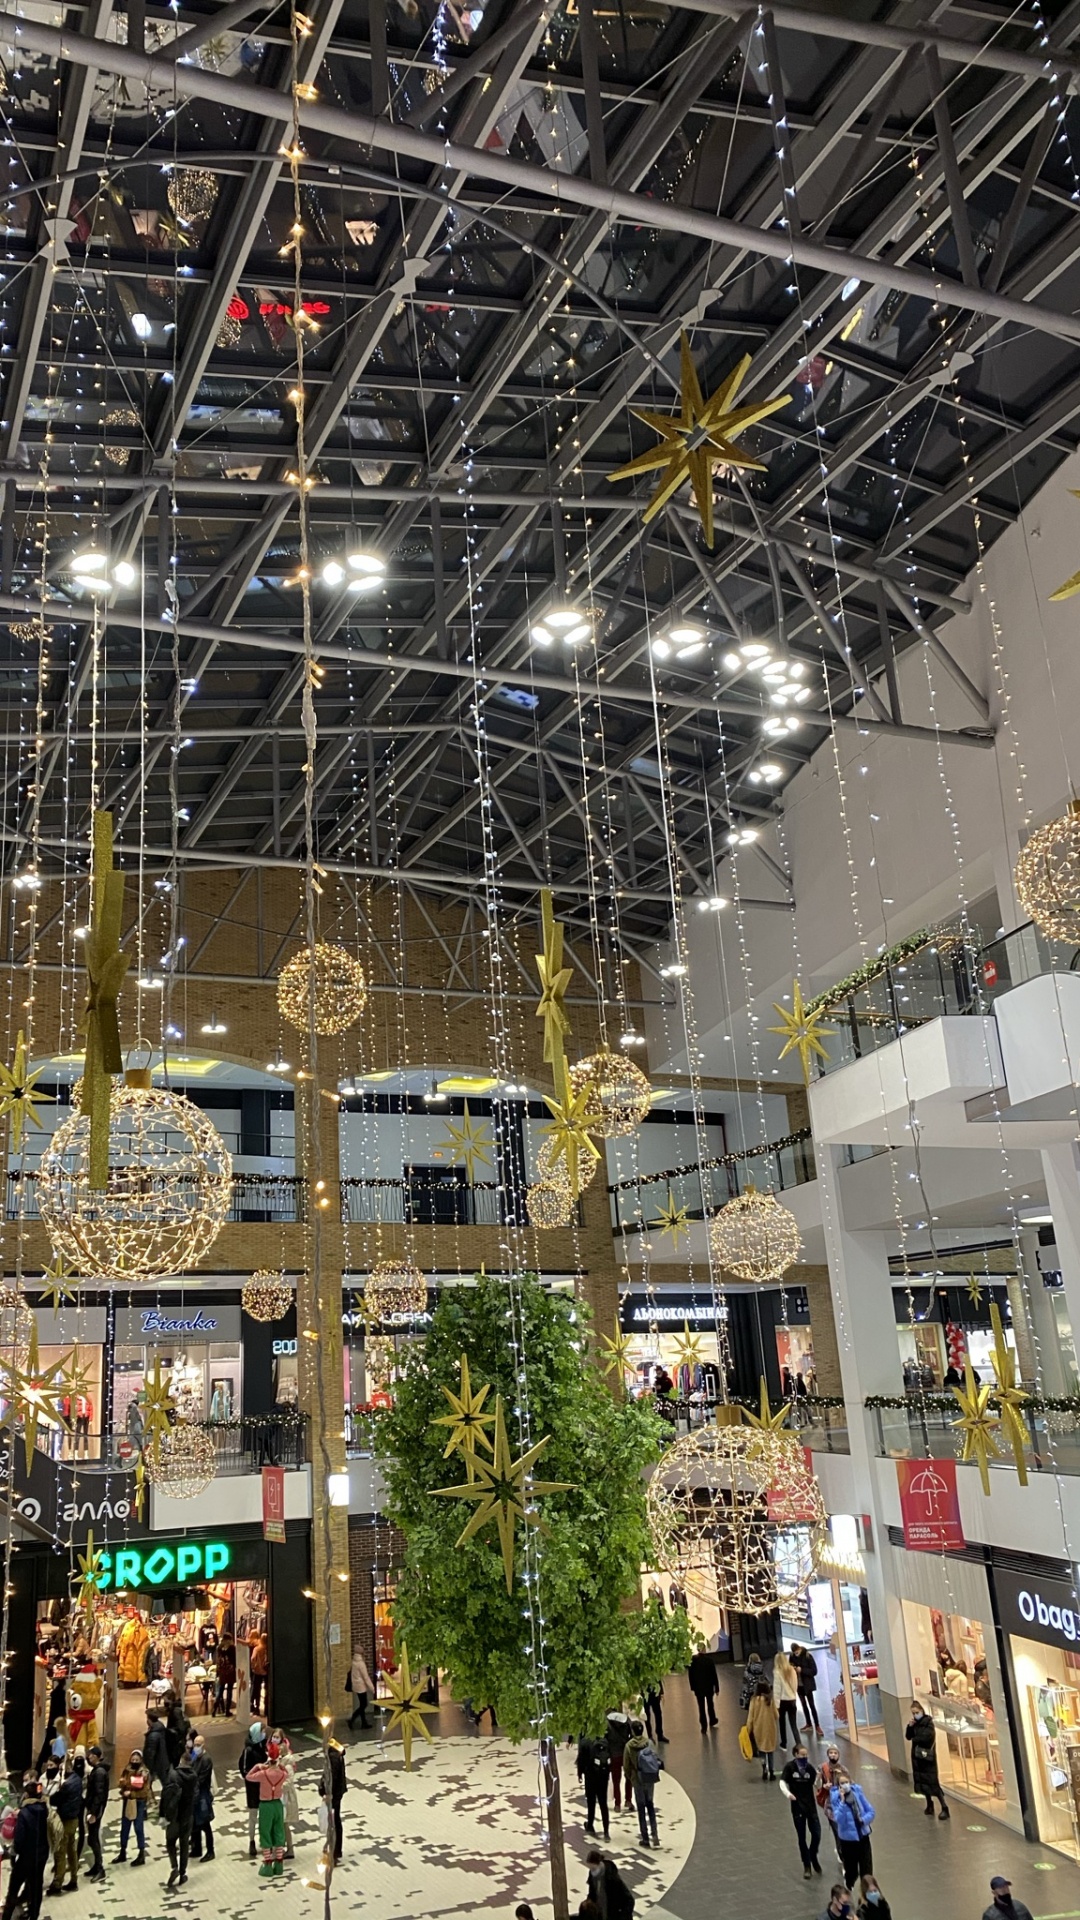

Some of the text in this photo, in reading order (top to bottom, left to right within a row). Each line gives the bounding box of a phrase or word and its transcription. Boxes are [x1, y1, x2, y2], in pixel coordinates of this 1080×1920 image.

[140, 1310, 217, 1332] Bianka
[381, 1312, 434, 1325] LOREN
[91, 1544, 229, 1588] CROPP
[1034, 1593, 1076, 1641] bag
